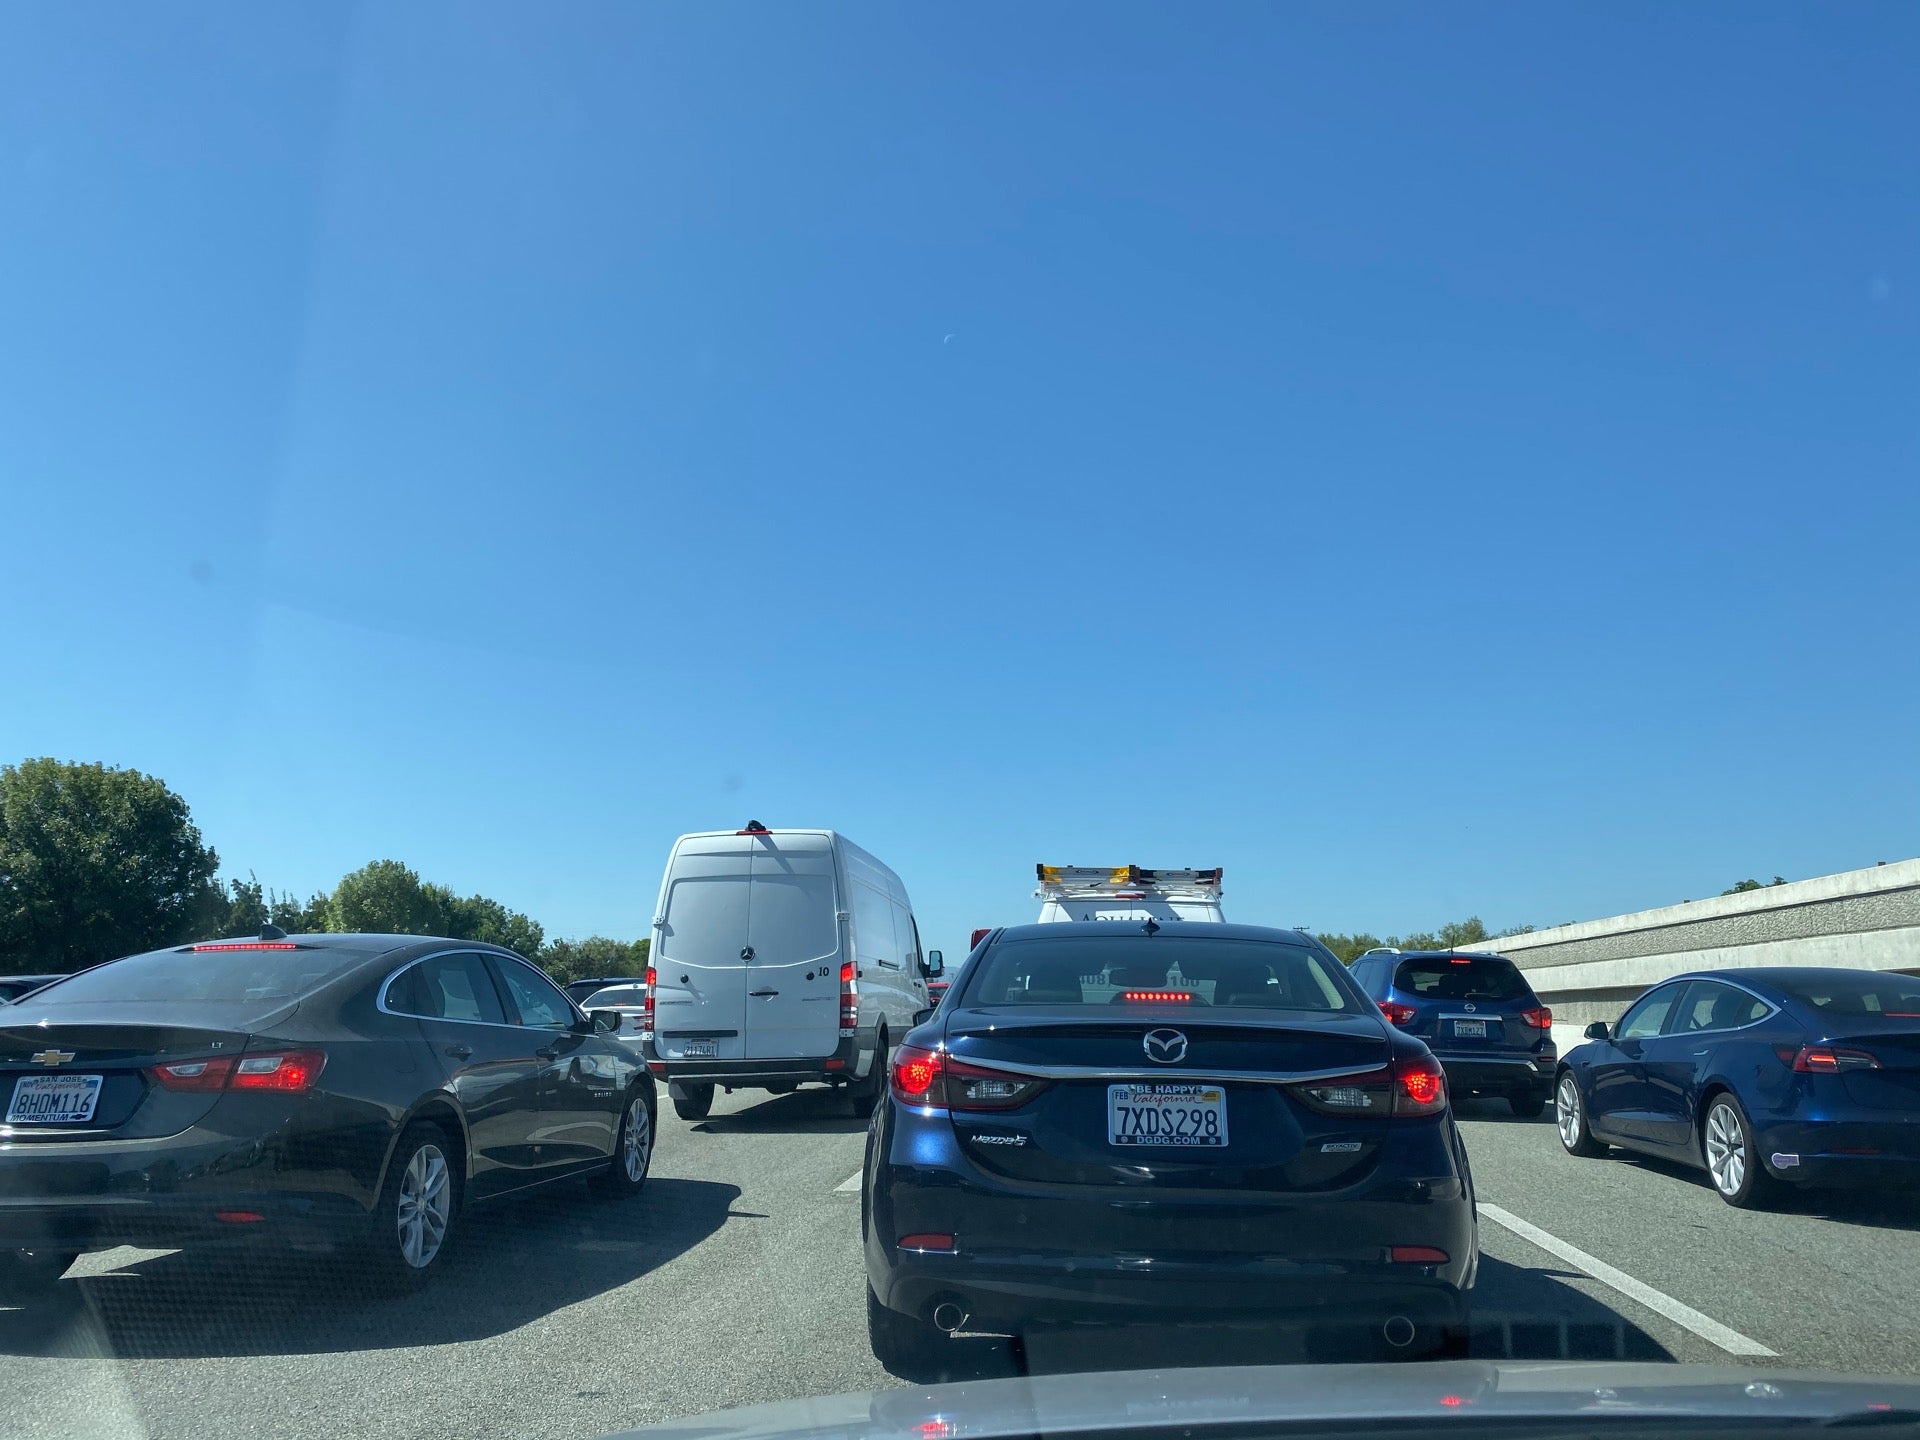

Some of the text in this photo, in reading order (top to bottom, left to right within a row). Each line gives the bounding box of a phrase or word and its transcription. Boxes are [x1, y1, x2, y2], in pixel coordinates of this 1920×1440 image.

[818, 966, 830, 977] 10
[211, 1041, 224, 1049] LT
[1136, 1085, 1196, 1094] BE HAPPY
[1115, 1091, 1129, 1100] FEB
[1133, 1094, 1203, 1107] California
[1116, 1106, 1218, 1137] 7XDS298
[1136, 1136, 1201, 1145] DGDG.COM
